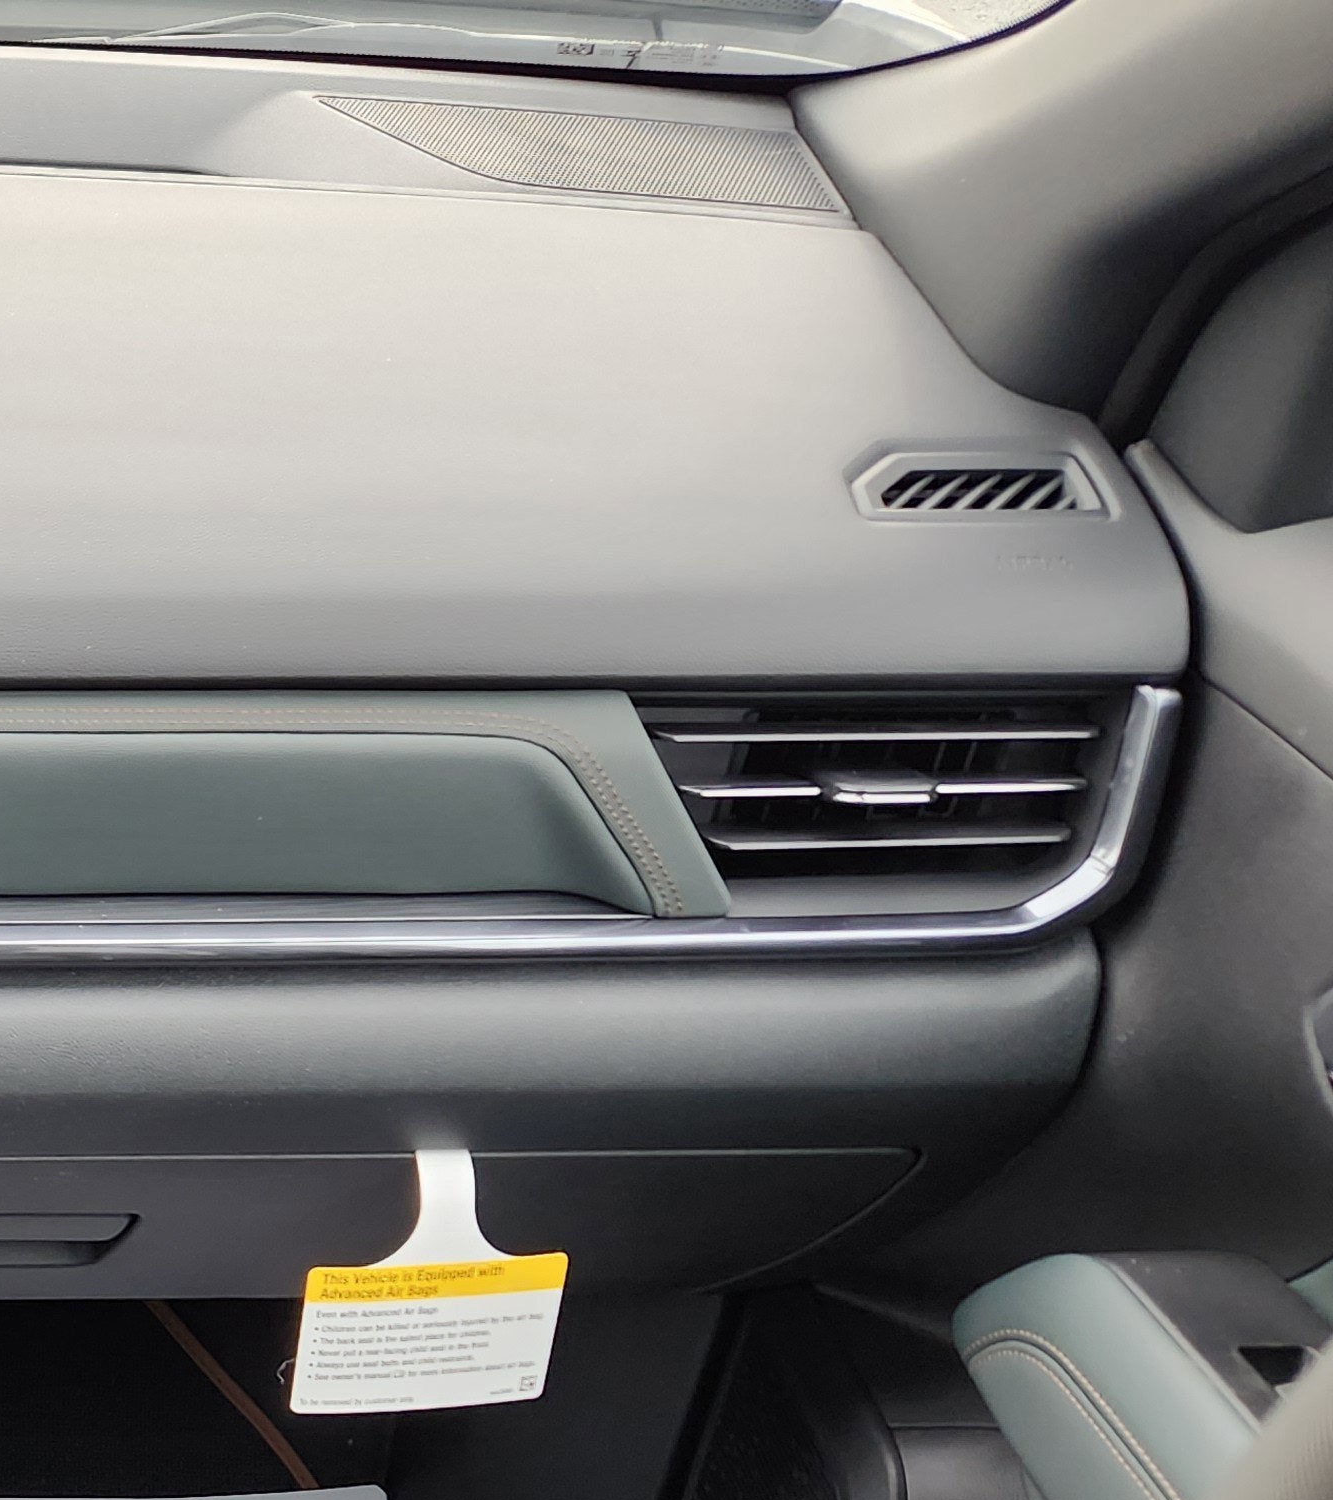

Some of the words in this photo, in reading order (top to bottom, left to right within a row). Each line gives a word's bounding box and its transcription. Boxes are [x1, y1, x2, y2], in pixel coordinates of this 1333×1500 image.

[322, 1272, 348, 1286] This
[353, 1269, 398, 1284] Vehicle
[417, 1265, 475, 1280] Equipped
[478, 1263, 505, 1276] with
[319, 1286, 382, 1301] Advanced
[386, 1285, 403, 1297] Air
[406, 1283, 439, 1296] Bags
